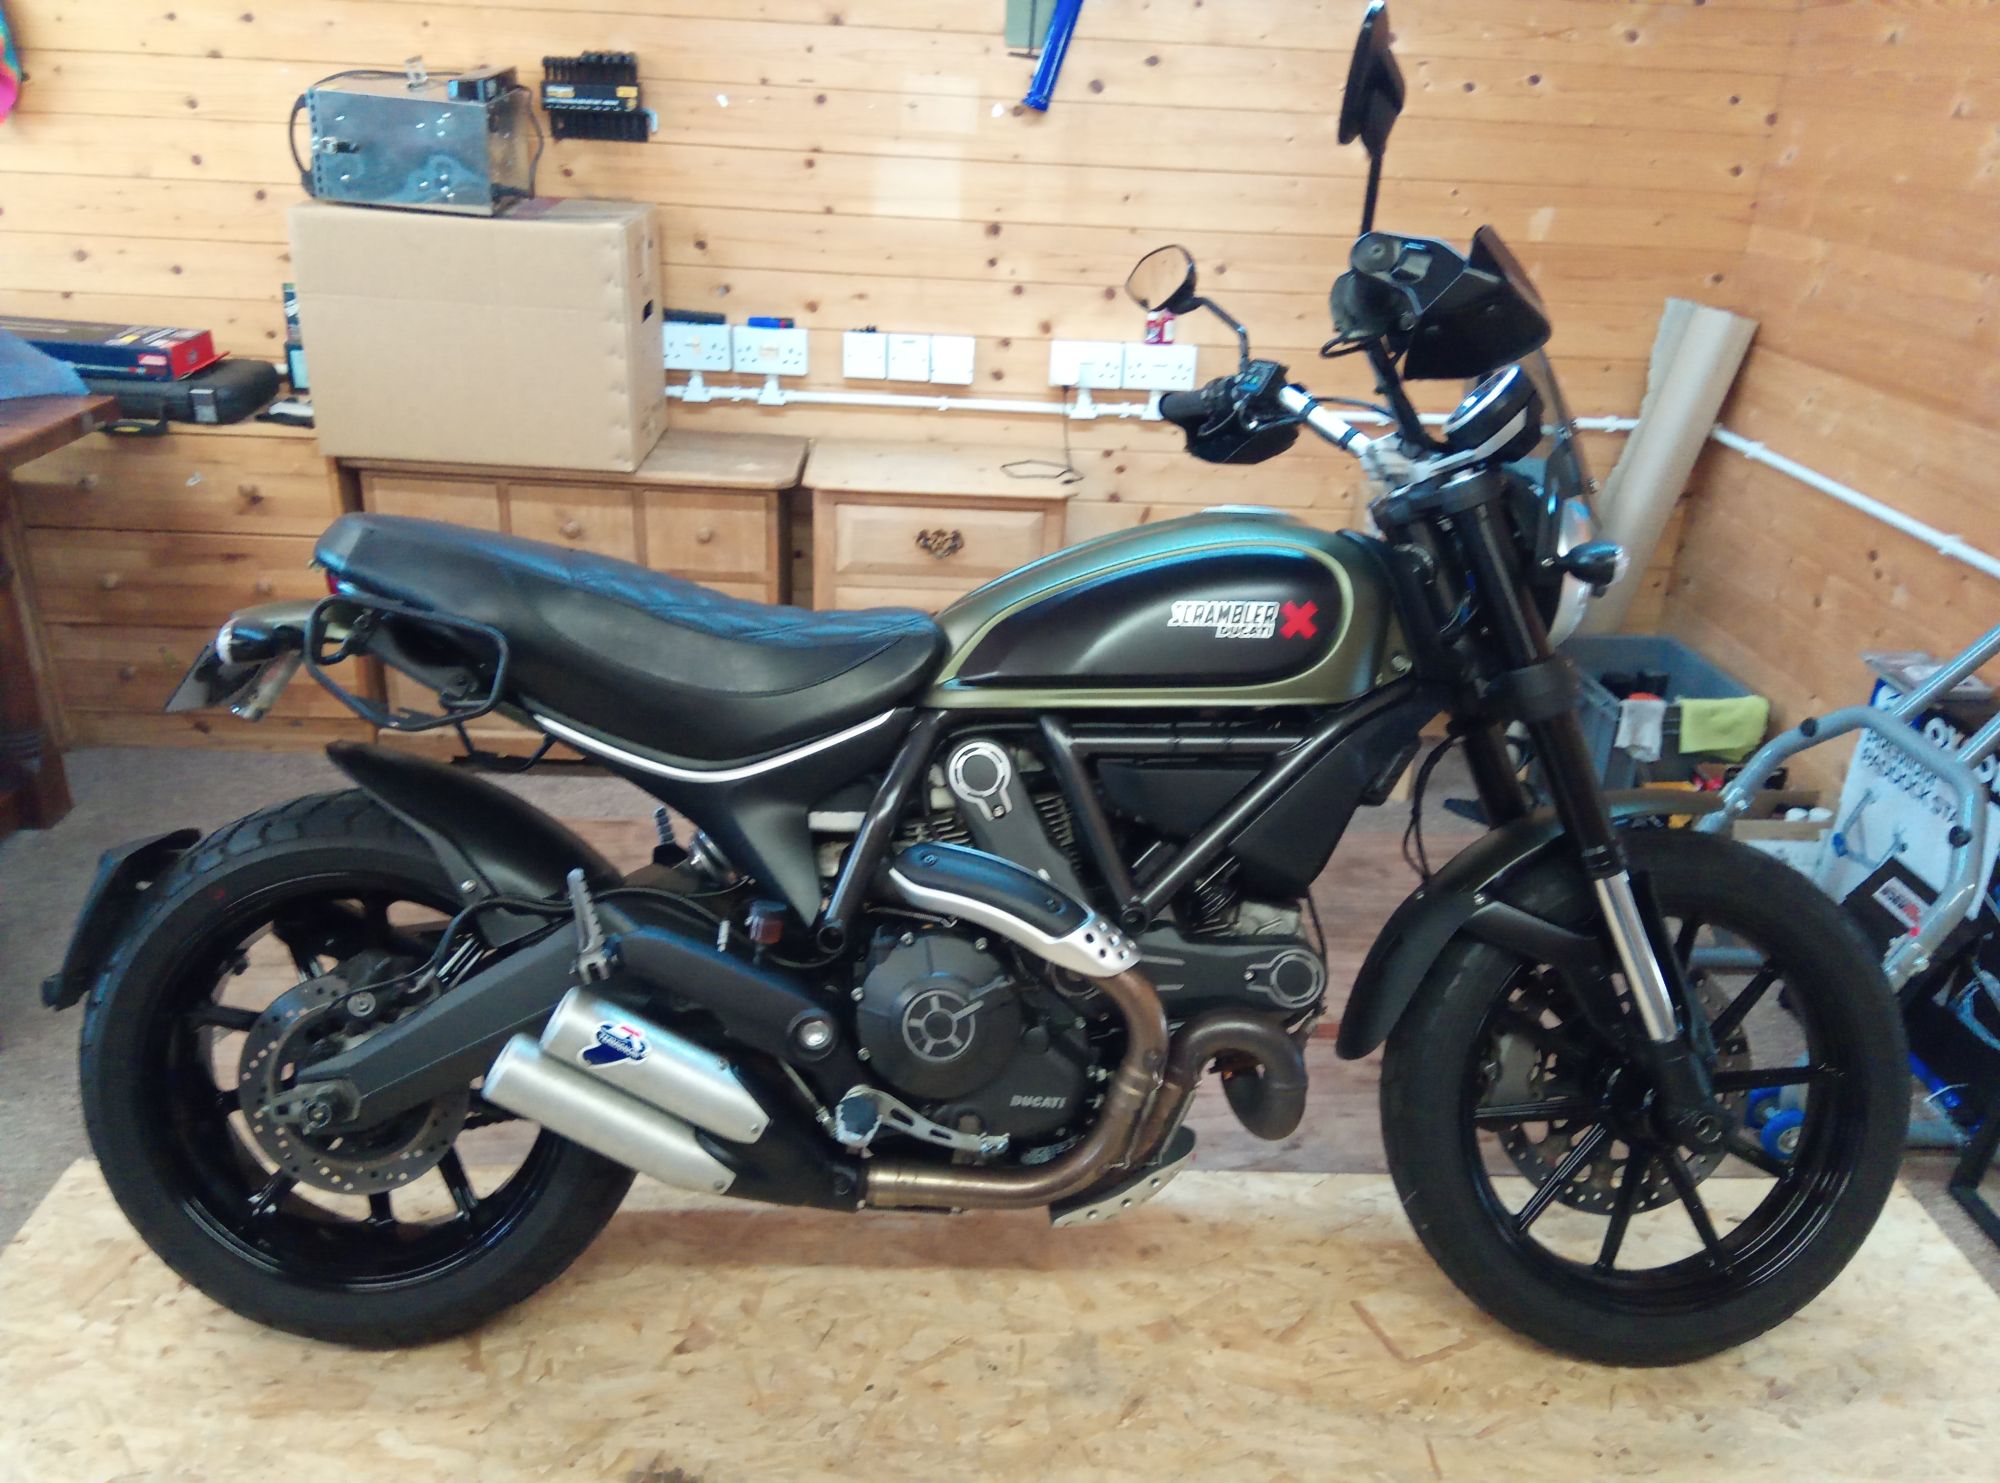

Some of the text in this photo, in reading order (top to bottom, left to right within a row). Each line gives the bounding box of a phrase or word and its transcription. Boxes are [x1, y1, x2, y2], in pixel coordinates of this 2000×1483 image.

[1167, 601, 1279, 626] SCRAMBLER
[1216, 625, 1274, 637] DUCATI
[1009, 1094, 1067, 1109] DUCATI
